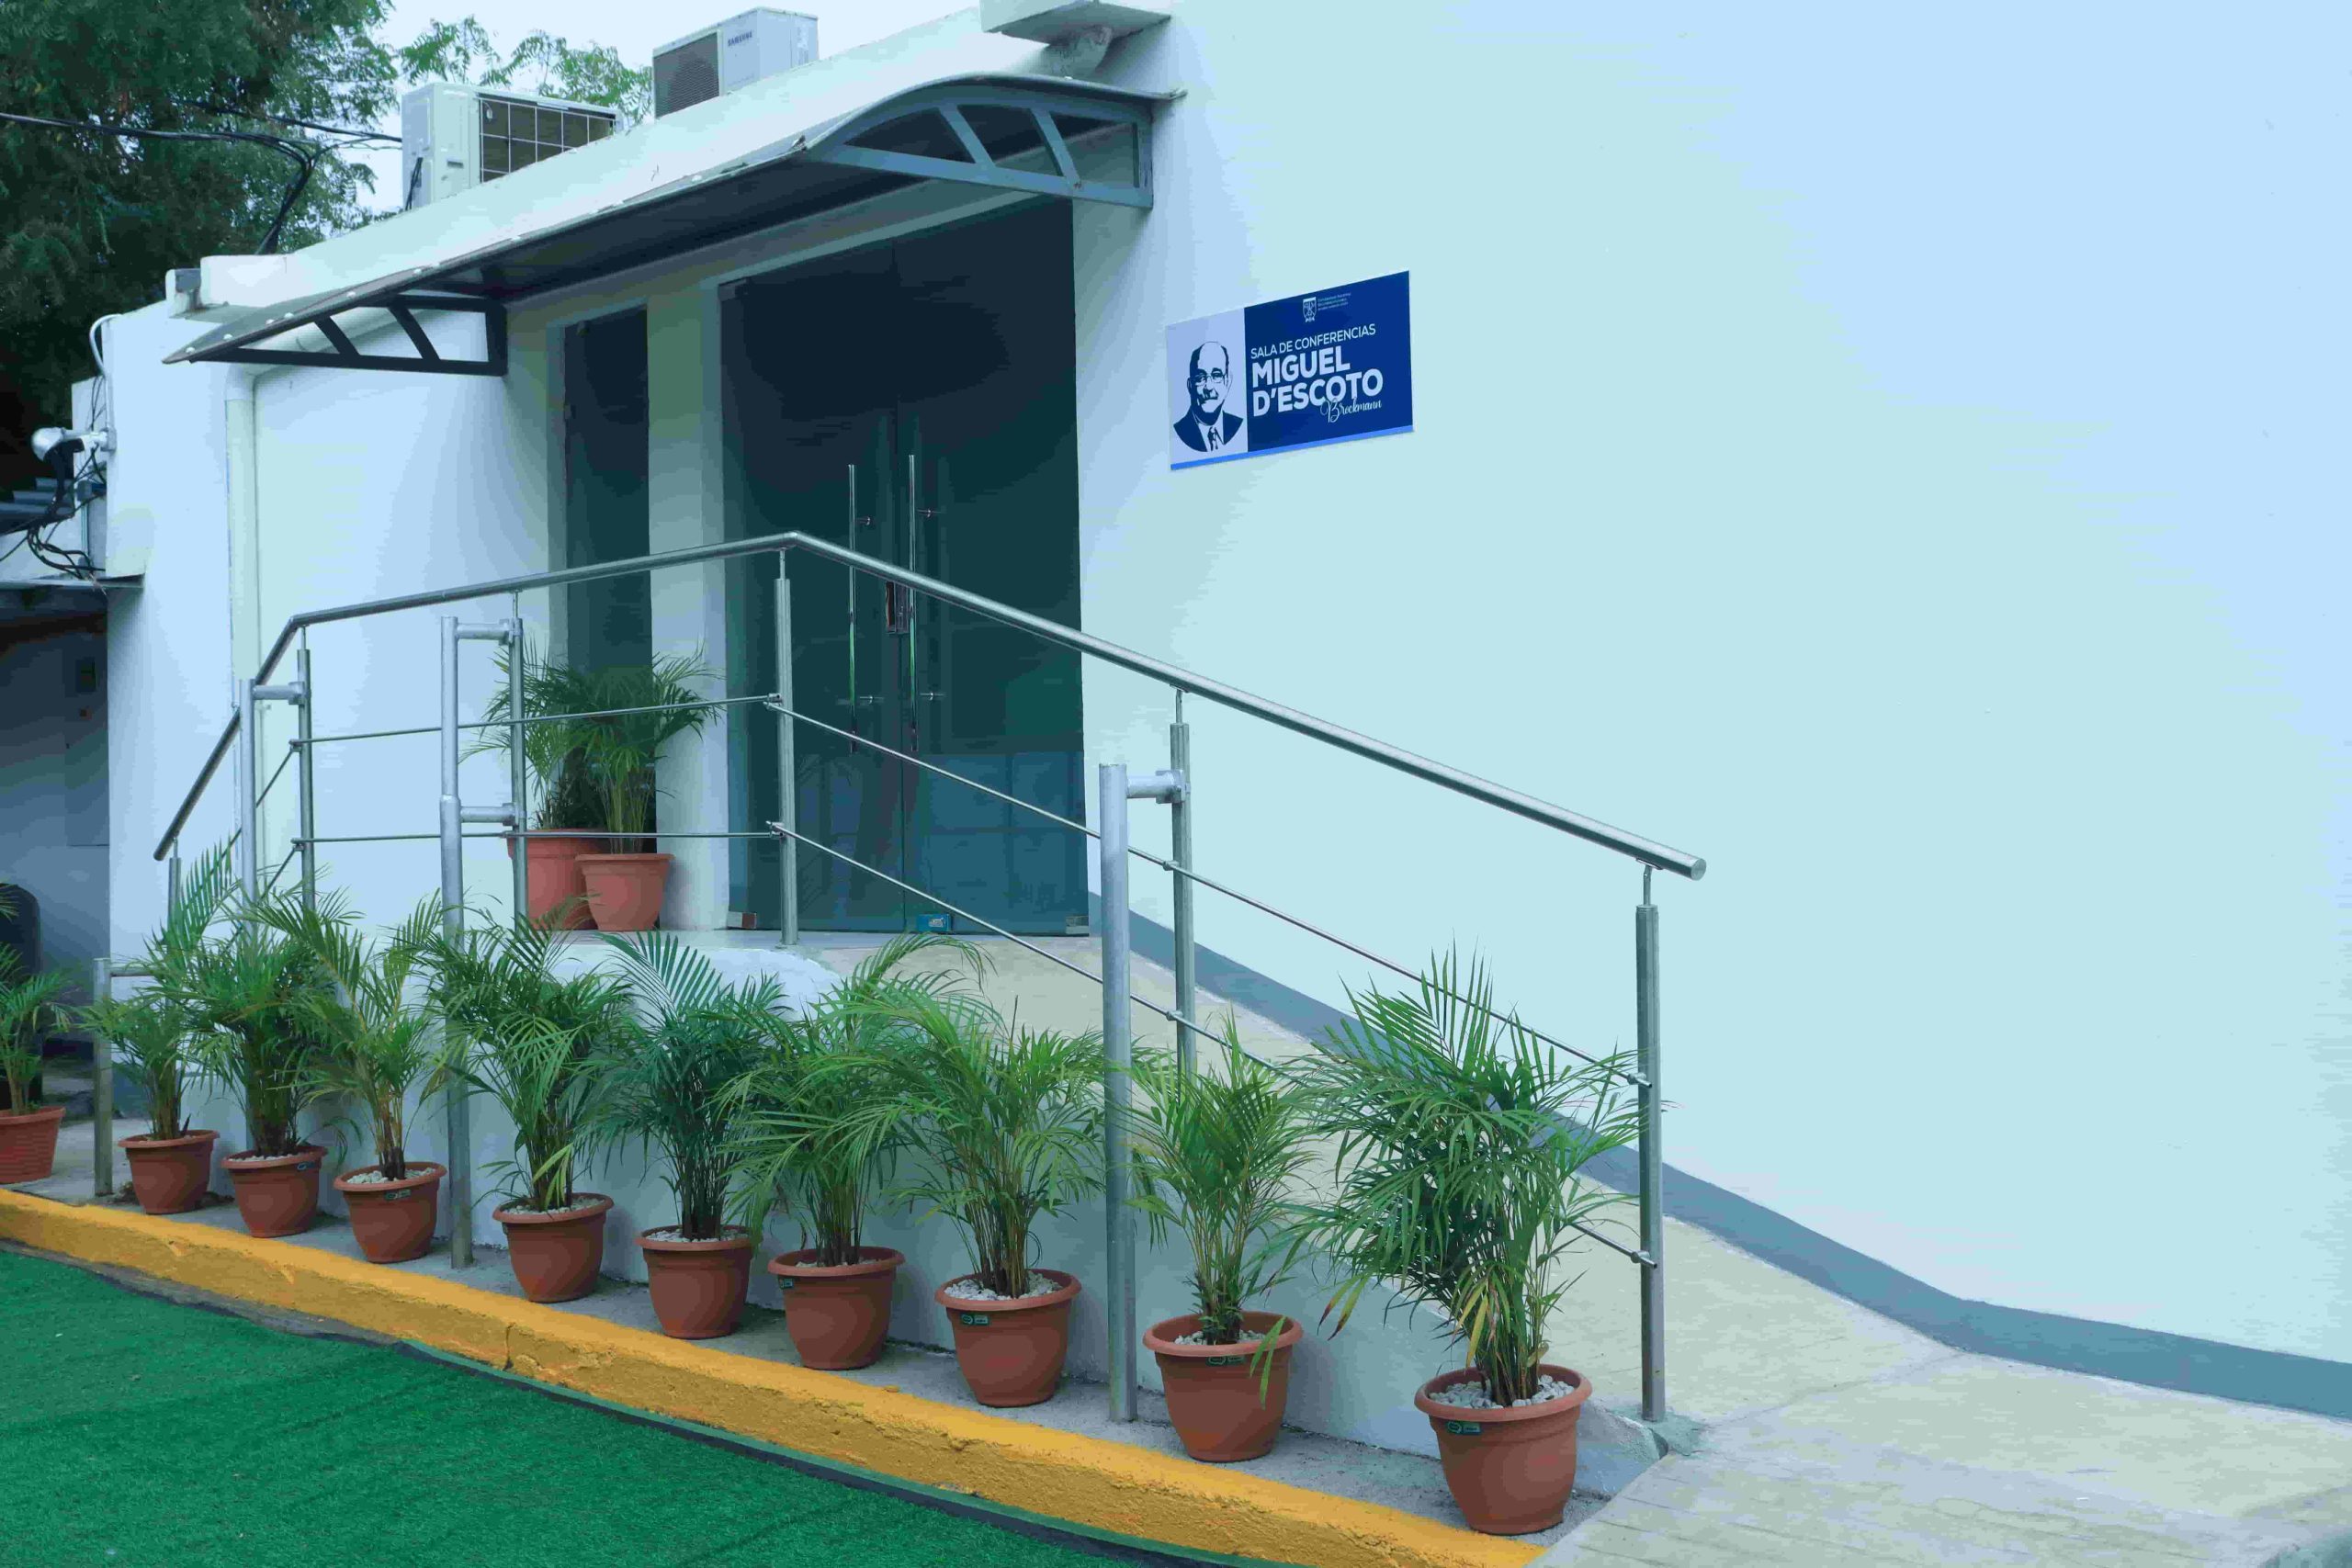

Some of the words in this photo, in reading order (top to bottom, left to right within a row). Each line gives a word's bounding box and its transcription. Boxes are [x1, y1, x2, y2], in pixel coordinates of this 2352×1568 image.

[1250, 344, 1278, 359] SALA
[1279, 340, 1294, 354] DE
[1295, 323, 1376, 350] CONFERENCIAS
[1252, 345, 1351, 388] MIGUEL
[1252, 368, 1384, 417] D'ESCOTO
